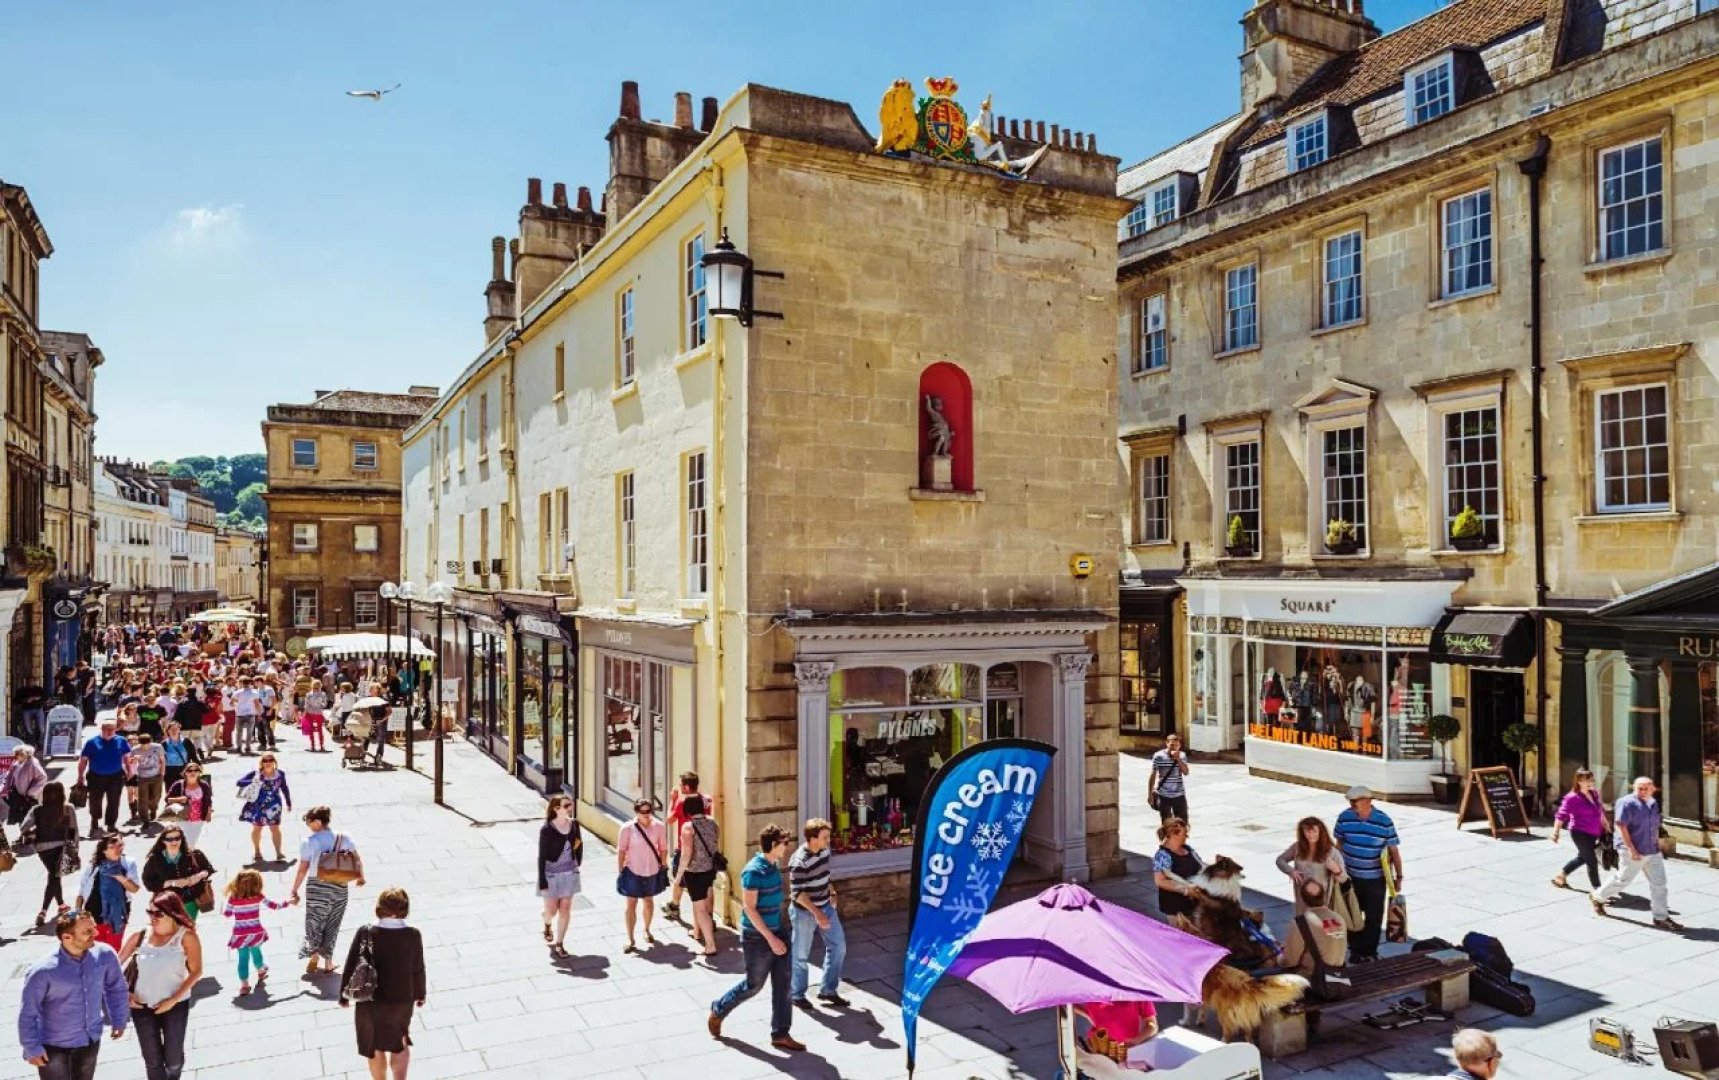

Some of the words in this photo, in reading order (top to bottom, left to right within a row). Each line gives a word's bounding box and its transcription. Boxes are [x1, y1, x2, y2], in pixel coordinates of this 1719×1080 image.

[1280, 598, 1331, 614] SQUARE
[1249, 723, 1300, 745] HELMUT
[1302, 731, 1338, 750] LANG
[938, 763, 1038, 846] cream
